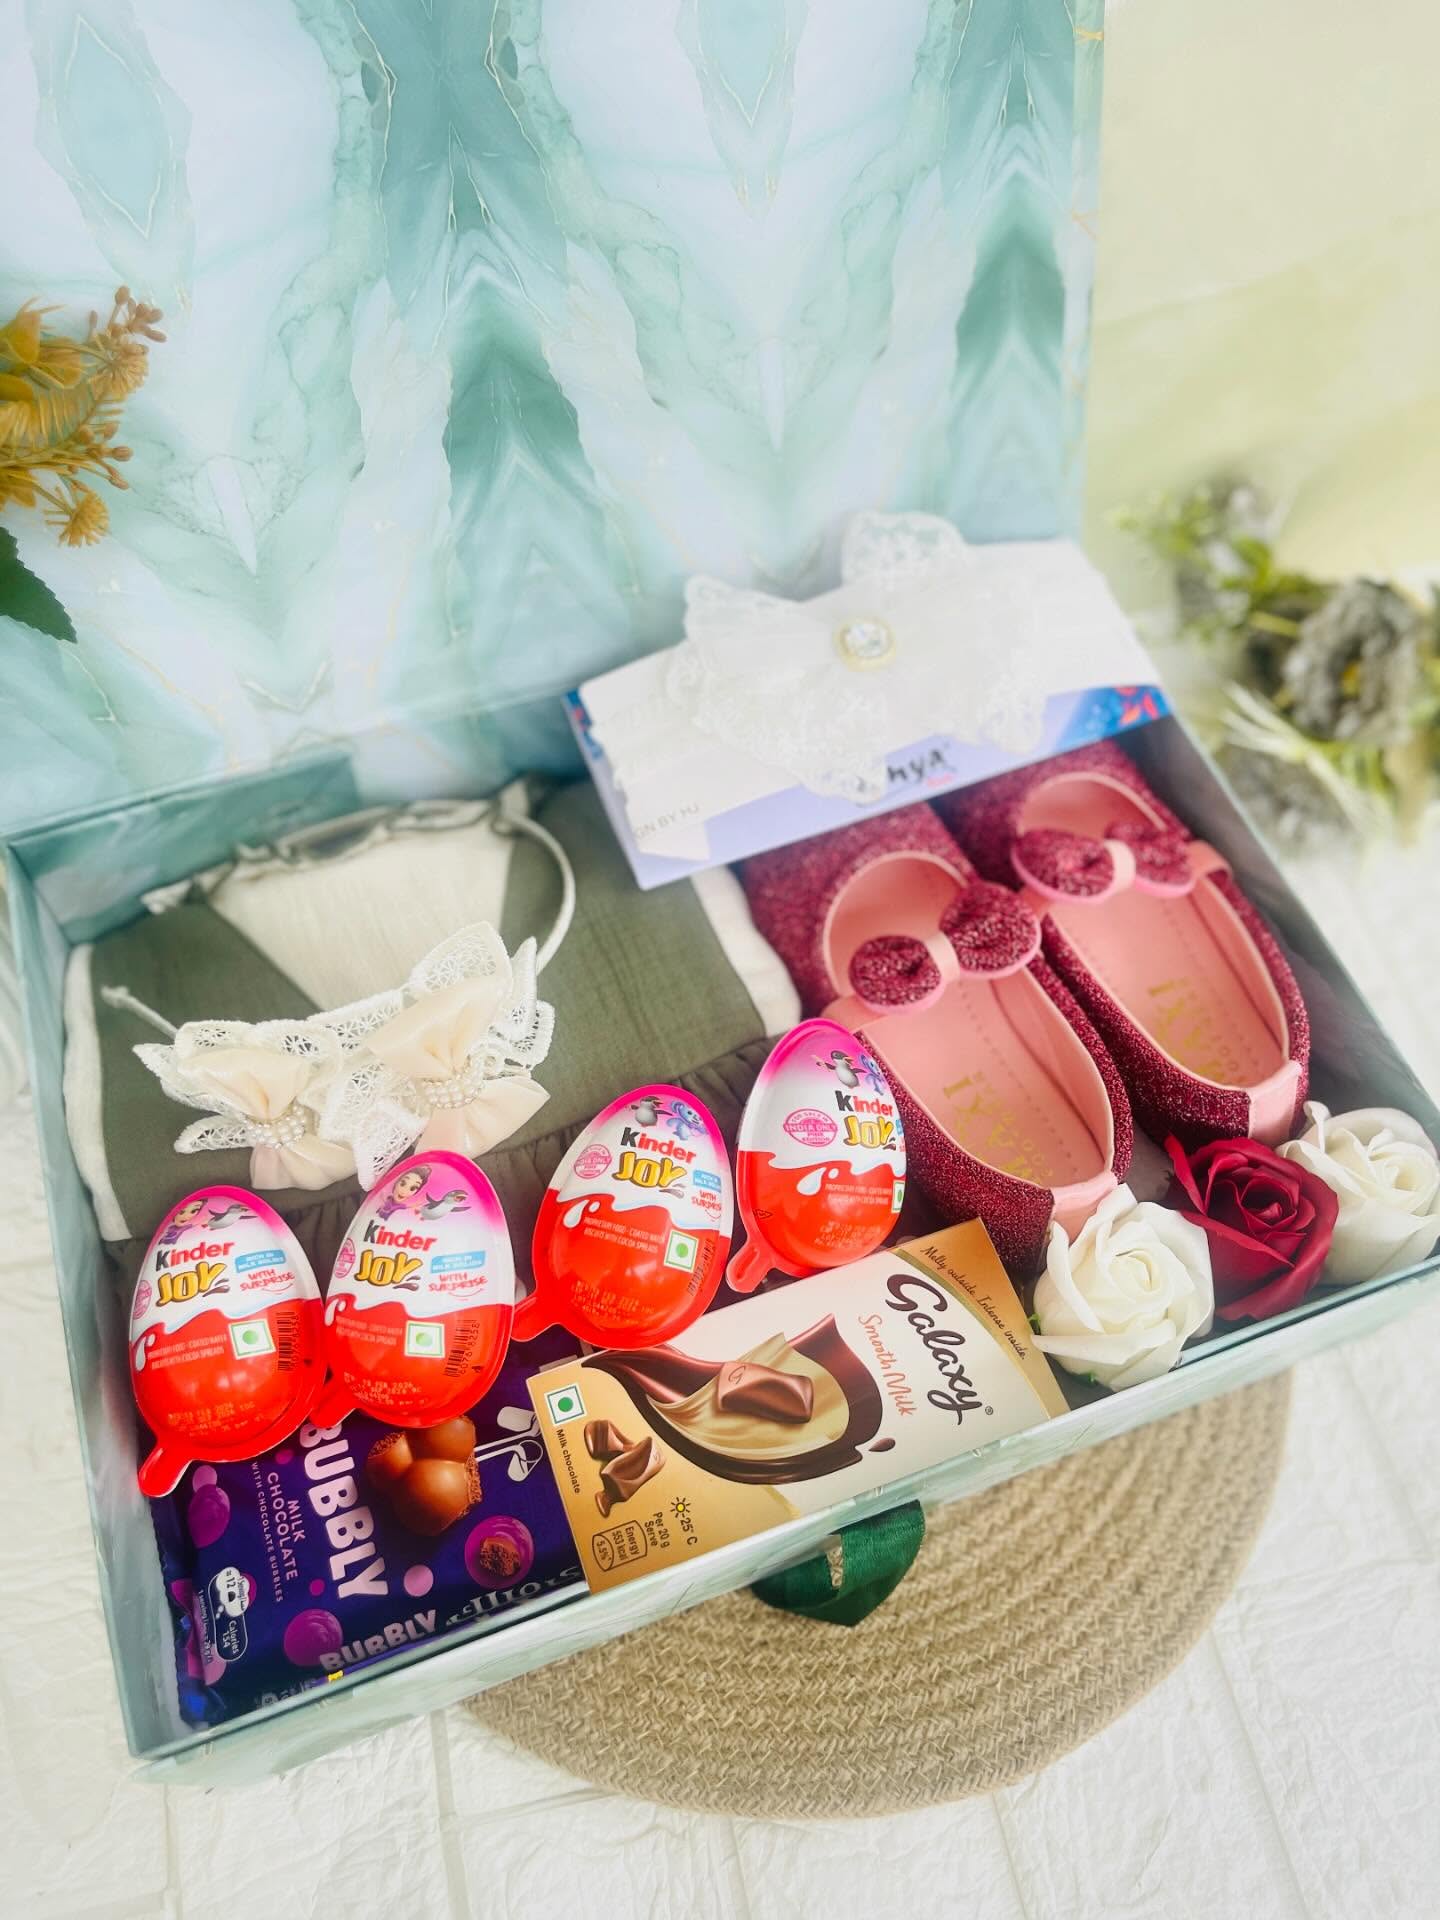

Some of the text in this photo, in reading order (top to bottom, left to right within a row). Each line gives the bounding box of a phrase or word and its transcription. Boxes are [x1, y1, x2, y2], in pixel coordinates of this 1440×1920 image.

[834, 1090, 893, 1117] Kinder
[620, 1126, 697, 1164] Kinder
[843, 1115, 895, 1149] JOY
[612, 1151, 688, 1188] JOY
[363, 1219, 438, 1251] Kinder
[155, 1241, 236, 1272] Kinder
[354, 1249, 424, 1286] JOY
[155, 1261, 228, 1307] JOY
[240, 1272, 295, 1291] SURPRISE
[248, 1269, 276, 1281] WITH
[428, 1275, 489, 1293] SURPRISE
[439, 1271, 468, 1283] WITH
[857, 1313, 918, 1417] Smooth Milk
[885, 1273, 983, 1426] Galaxy
[555, 1428, 581, 1494] Milk chocolate
[267, 1471, 299, 1582] CHOCOLATE
[287, 1499, 306, 1542] MILK
[300, 1421, 389, 1599] BUBBLY
[652, 1511, 664, 1528] Per
[250, 1461, 285, 1603] WITH CHOCOLATE BUBBLES
[624, 1525, 641, 1556] Energy
[644, 1521, 659, 1548] Serve
[226, 1619, 242, 1653] Calories
[319, 1609, 437, 1671] BUBBLY
